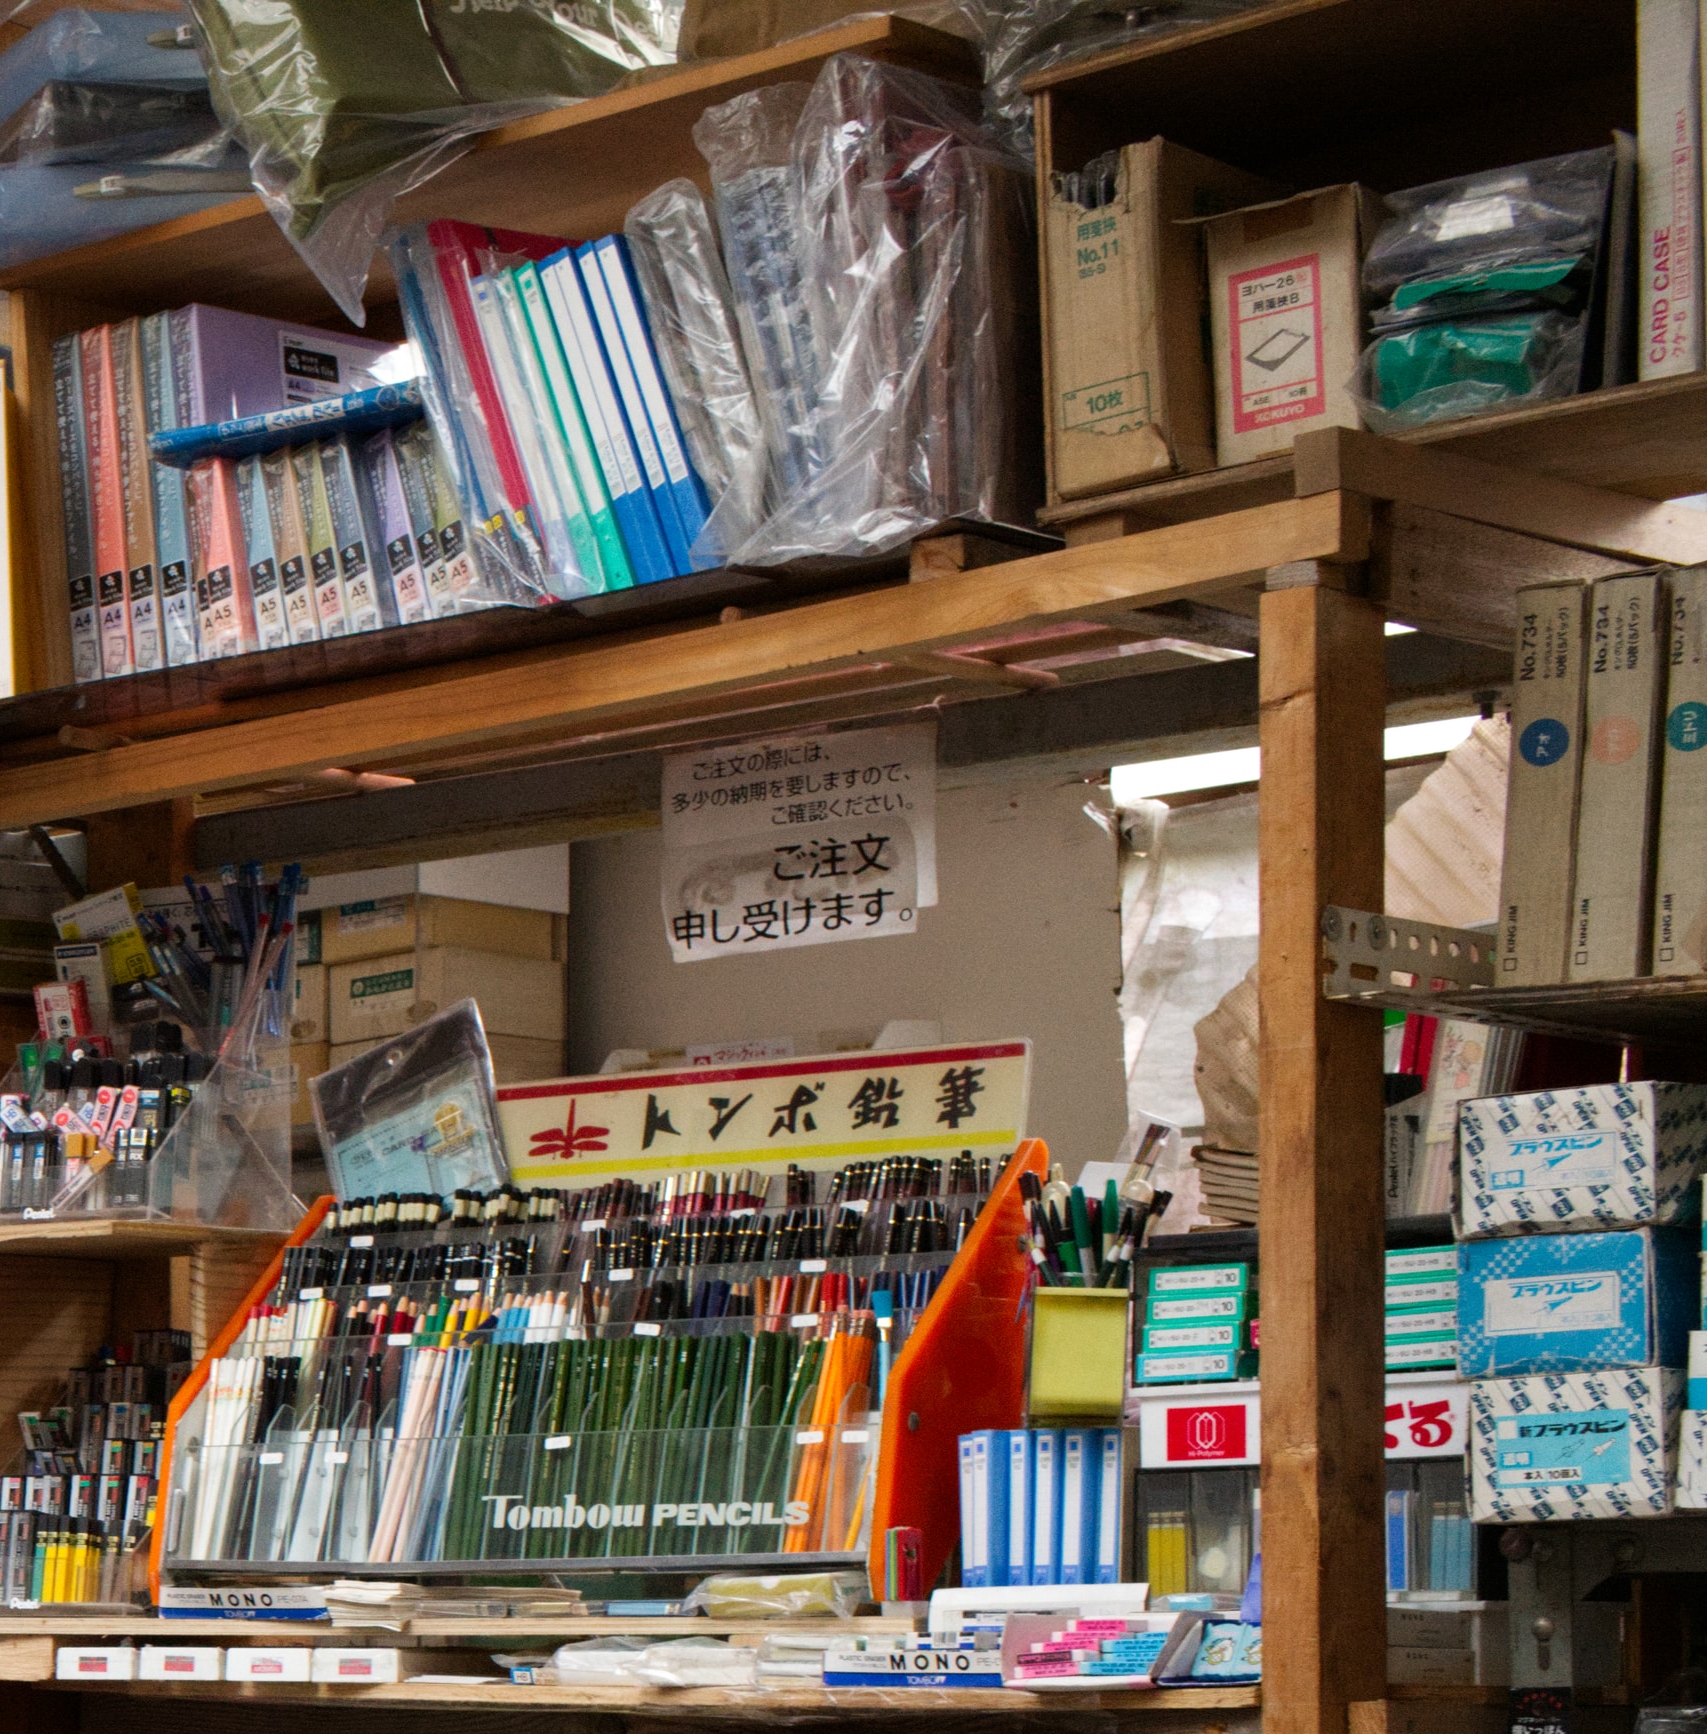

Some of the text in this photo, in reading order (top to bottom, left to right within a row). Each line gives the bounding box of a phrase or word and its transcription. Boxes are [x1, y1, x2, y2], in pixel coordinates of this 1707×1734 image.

[1077, 238, 1120, 267] No.11
[1649, 225, 1671, 364] CARD CASE
[1086, 388, 1125, 415] 10枚
[1255, 403, 1305, 423] KOKUYO
[320, 589, 337, 606] A5
[351, 581, 368, 599] A5
[134, 602, 152, 619] A4
[214, 604, 232, 622] A5
[260, 597, 277, 615] A5
[290, 598, 307, 615] A5
[74, 612, 92, 631] A4
[103, 608, 122, 625] A4
[1520, 613, 1538, 681] No.734
[1593, 605, 1610, 673] No.734
[1681, 710, 1698, 746] ミドリ
[1535, 732, 1551, 758] アオ
[692, 743, 830, 782] ご注文の際には、
[672, 762, 912, 815] 多少の納期を要しますので、
[771, 793, 915, 826] ご確認ください。
[773, 832, 891, 881] ご注文
[672, 888, 913, 950] 申し受けます。
[1578, 898, 1589, 948] KING JIM
[1662, 893, 1674, 944] KING JIM
[1505, 905, 1518, 954] KING JIM
[641, 1065, 987, 1151] トンボ鉛筆
[1507, 1136, 1603, 1157] ブラウスピン
[23, 1207, 53, 1220] Pentel
[1224, 1271, 1237, 1284] 10
[1510, 1279, 1603, 1299] ブラウスピン
[1221, 1300, 1234, 1312] 10
[1218, 1329, 1230, 1341] 10
[1213, 1358, 1225, 1370] 10
[481, 1493, 811, 1531] Tombow PENCILS
[9, 1598, 41, 1611] Pentel
[209, 1592, 275, 1607] MONO
[890, 1653, 971, 1671] MONO
